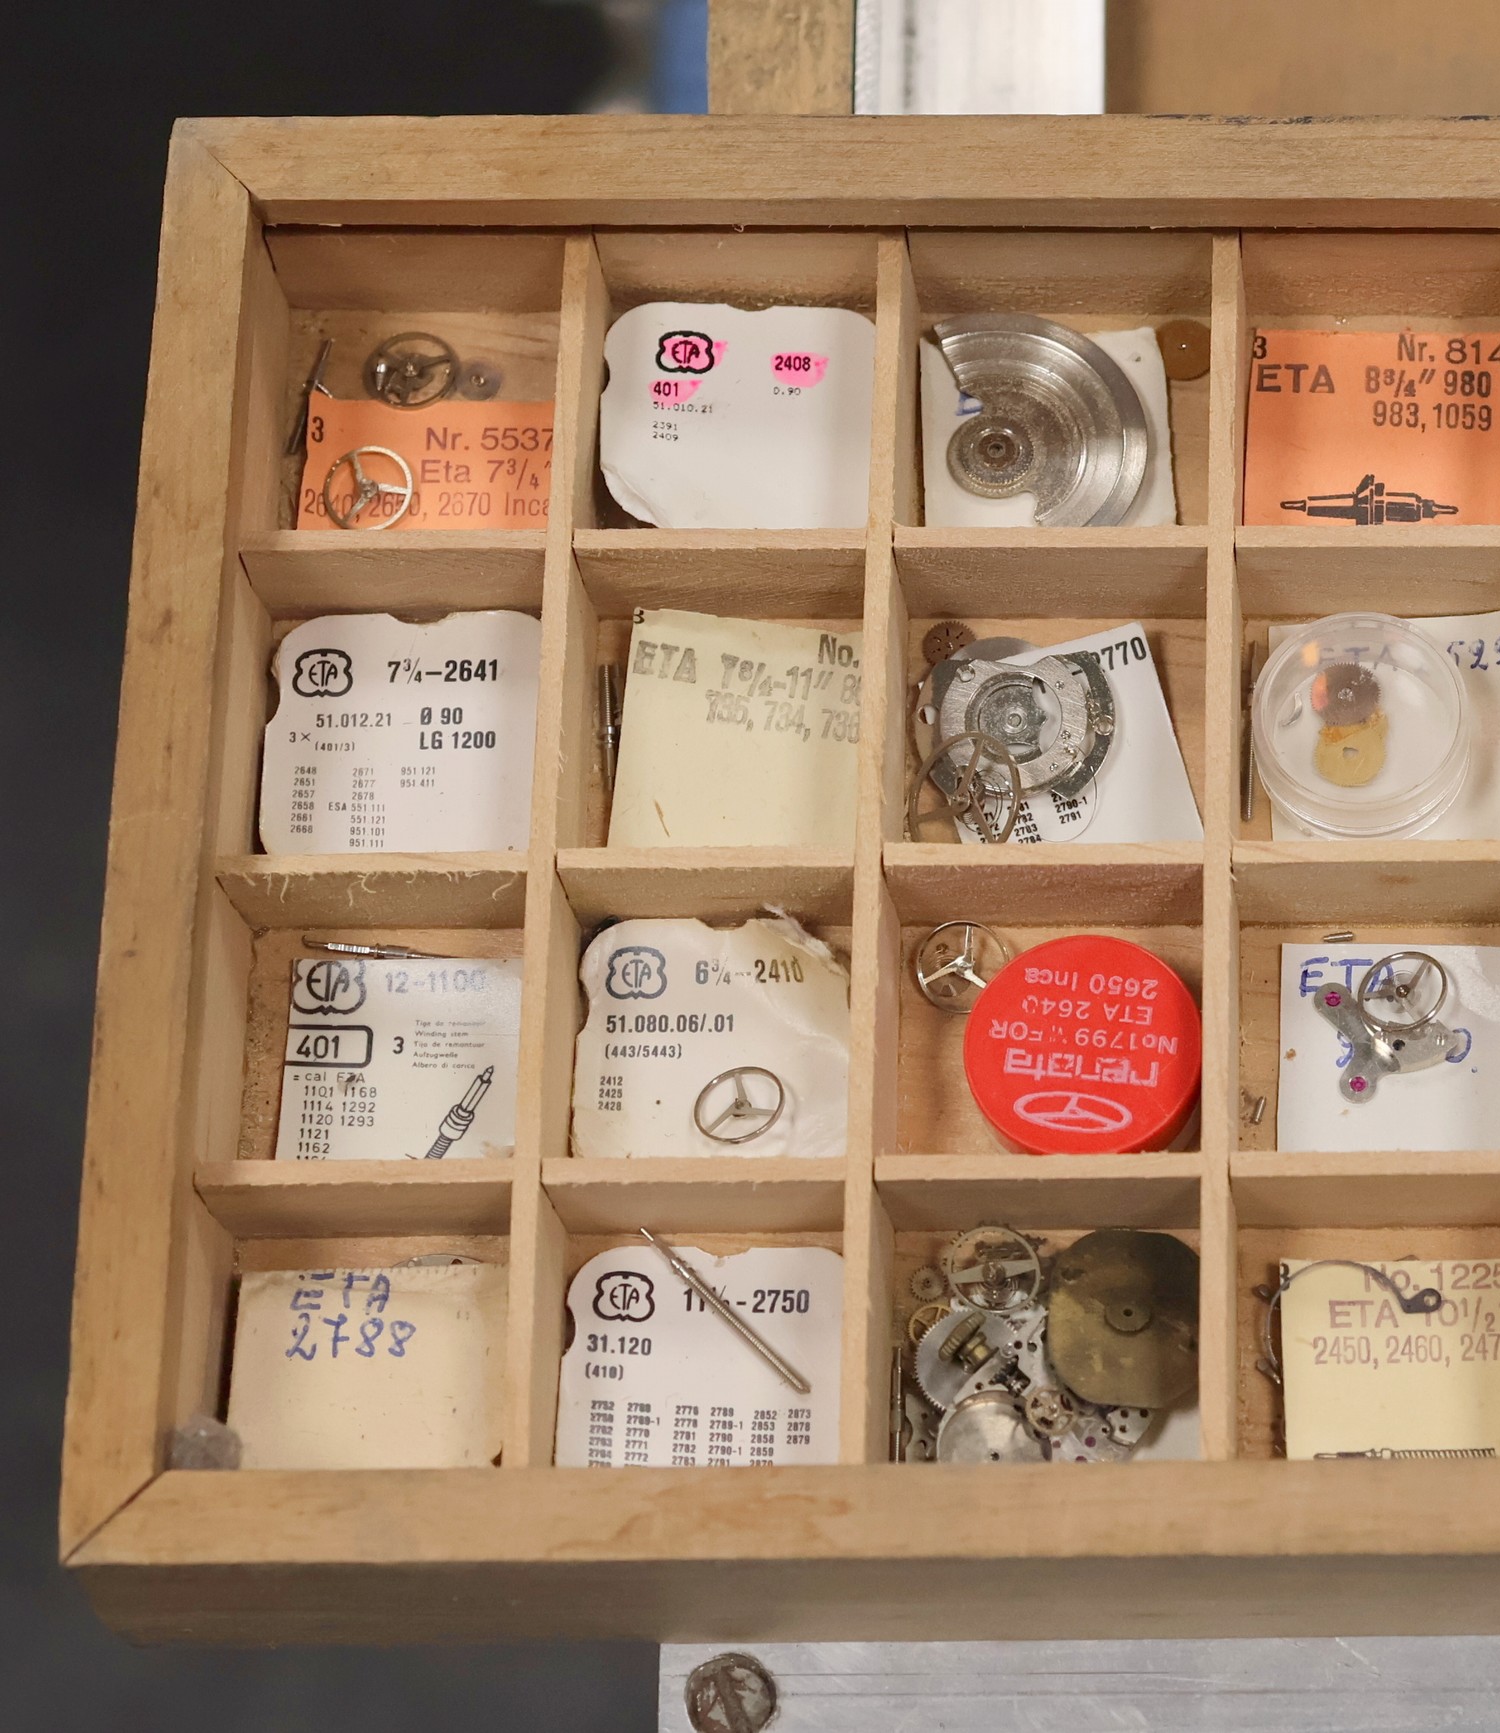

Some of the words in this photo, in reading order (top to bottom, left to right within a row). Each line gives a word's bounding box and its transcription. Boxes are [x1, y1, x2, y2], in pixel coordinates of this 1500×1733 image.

[671, 340, 701, 364] ETA
[1252, 336, 1267, 359] 3
[1397, 333, 1435, 362] Nr.
[774, 355, 811, 371] 2408
[653, 381, 679, 397] 401
[1256, 364, 1335, 394] ETA
[1443, 368, 1491, 398] 980
[653, 401, 713, 414] 51.010.21
[311, 416, 325, 443] 3
[426, 427, 469, 450] Nr.
[652, 431, 679, 442] 2409
[420, 459, 471, 484] Eta
[632, 640, 697, 683] ETA
[818, 634, 860, 668] No.
[308, 660, 338, 687] ETA
[316, 713, 392, 728] 51.012.21
[440, 707, 463, 725] 90
[315, 741, 355, 751] (401/3)
[419, 731, 443, 750] LG
[451, 731, 496, 749] 1200
[294, 766, 317, 775] 2648
[328, 802, 347, 811] ESA
[306, 960, 350, 1001] ETA
[385, 969, 487, 993] 12-1100
[622, 959, 651, 989] ETA
[1024, 967, 1079, 992] Inca
[1089, 973, 1159, 1000] 2650
[1021, 995, 1091, 1019] 2640
[1103, 1003, 1153, 1025] ETA
[606, 1014, 734, 1033] 51.080.06/.01
[988, 1019, 1043, 1042] FOR
[296, 1035, 339, 1059] 401
[393, 1036, 404, 1054] 3
[605, 1043, 682, 1059] (443/5443)
[304, 1085, 334, 1098] 1101
[343, 1086, 377, 1098] 1168
[600, 1076, 623, 1086] 2412
[599, 1088, 623, 1099] 2425
[303, 1100, 333, 1112] 1114
[342, 1101, 376, 1113] 1292
[598, 1101, 622, 1111] 2428
[301, 1113, 333, 1126] 1120
[340, 1115, 374, 1127] 1293
[300, 1128, 329, 1140] 1121
[298, 1142, 330, 1154] 1162
[290, 1272, 390, 1315] ETA
[610, 1283, 640, 1311] ETA
[1329, 1299, 1399, 1328] ETA
[285, 1312, 416, 1361] 2788
[587, 1334, 652, 1356] 31.120
[1312, 1336, 1379, 1369] 2450,
[1386, 1334, 1451, 1368] 2460,
[585, 1363, 624, 1381] (410)
